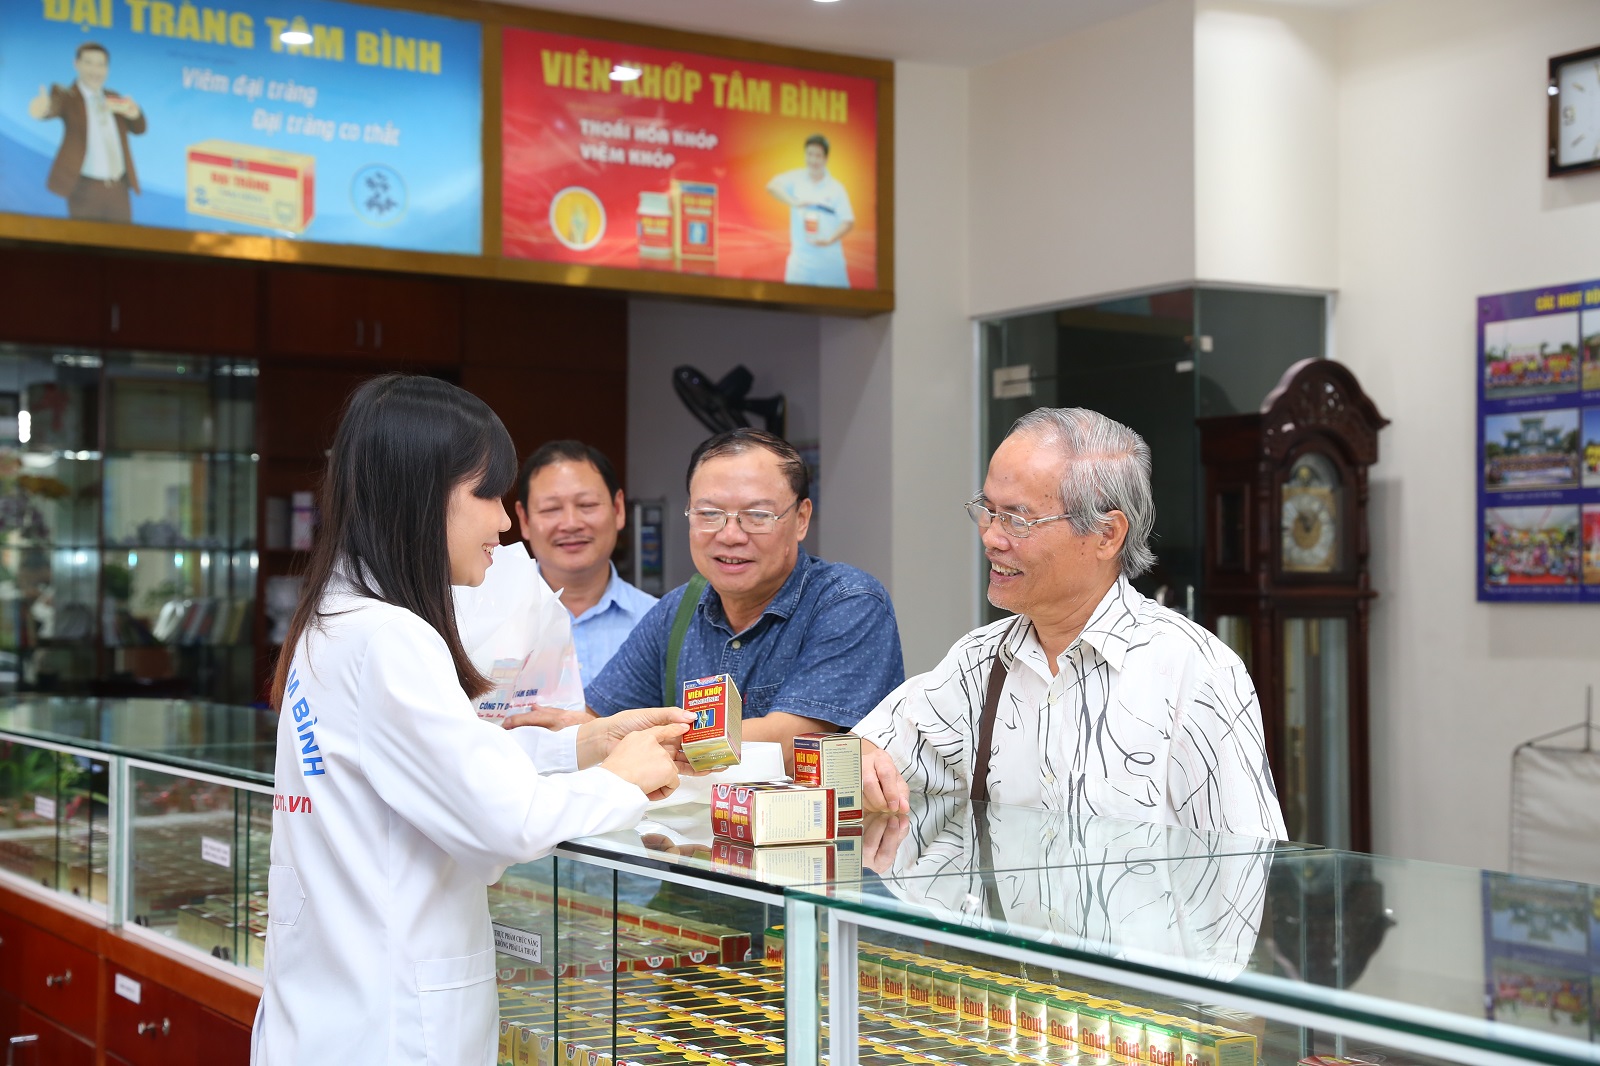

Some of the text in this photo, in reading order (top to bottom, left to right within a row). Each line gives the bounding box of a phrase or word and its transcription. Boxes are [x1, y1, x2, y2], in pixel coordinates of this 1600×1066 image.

[265, 15, 345, 62] TÂM
[356, 28, 442, 75] BÌNH
[540, 48, 612, 92] VIÊN
[709, 70, 771, 115] TÂM
[780, 79, 848, 123] BÌNH
[479, 701, 496, 710] CÔNG
[687, 689, 703, 700] VIÊN
[292, 697, 325, 776] BÌNH
[273, 795, 312, 814] om.vn
[860, 970, 878, 989] Gout
[884, 977, 903, 996] Gout
[910, 983, 929, 1003] Gout
[936, 990, 957, 1010] Gout
[963, 996, 985, 1017] Gout
[991, 1003, 1012, 1025] Gout
[1020, 1011, 1042, 1033] Gout
[1051, 1019, 1073, 1042] Gout
[1082, 1027, 1106, 1050] Gout
[1115, 1035, 1140, 1059] Gout
[1149, 1044, 1175, 1066] Gout
